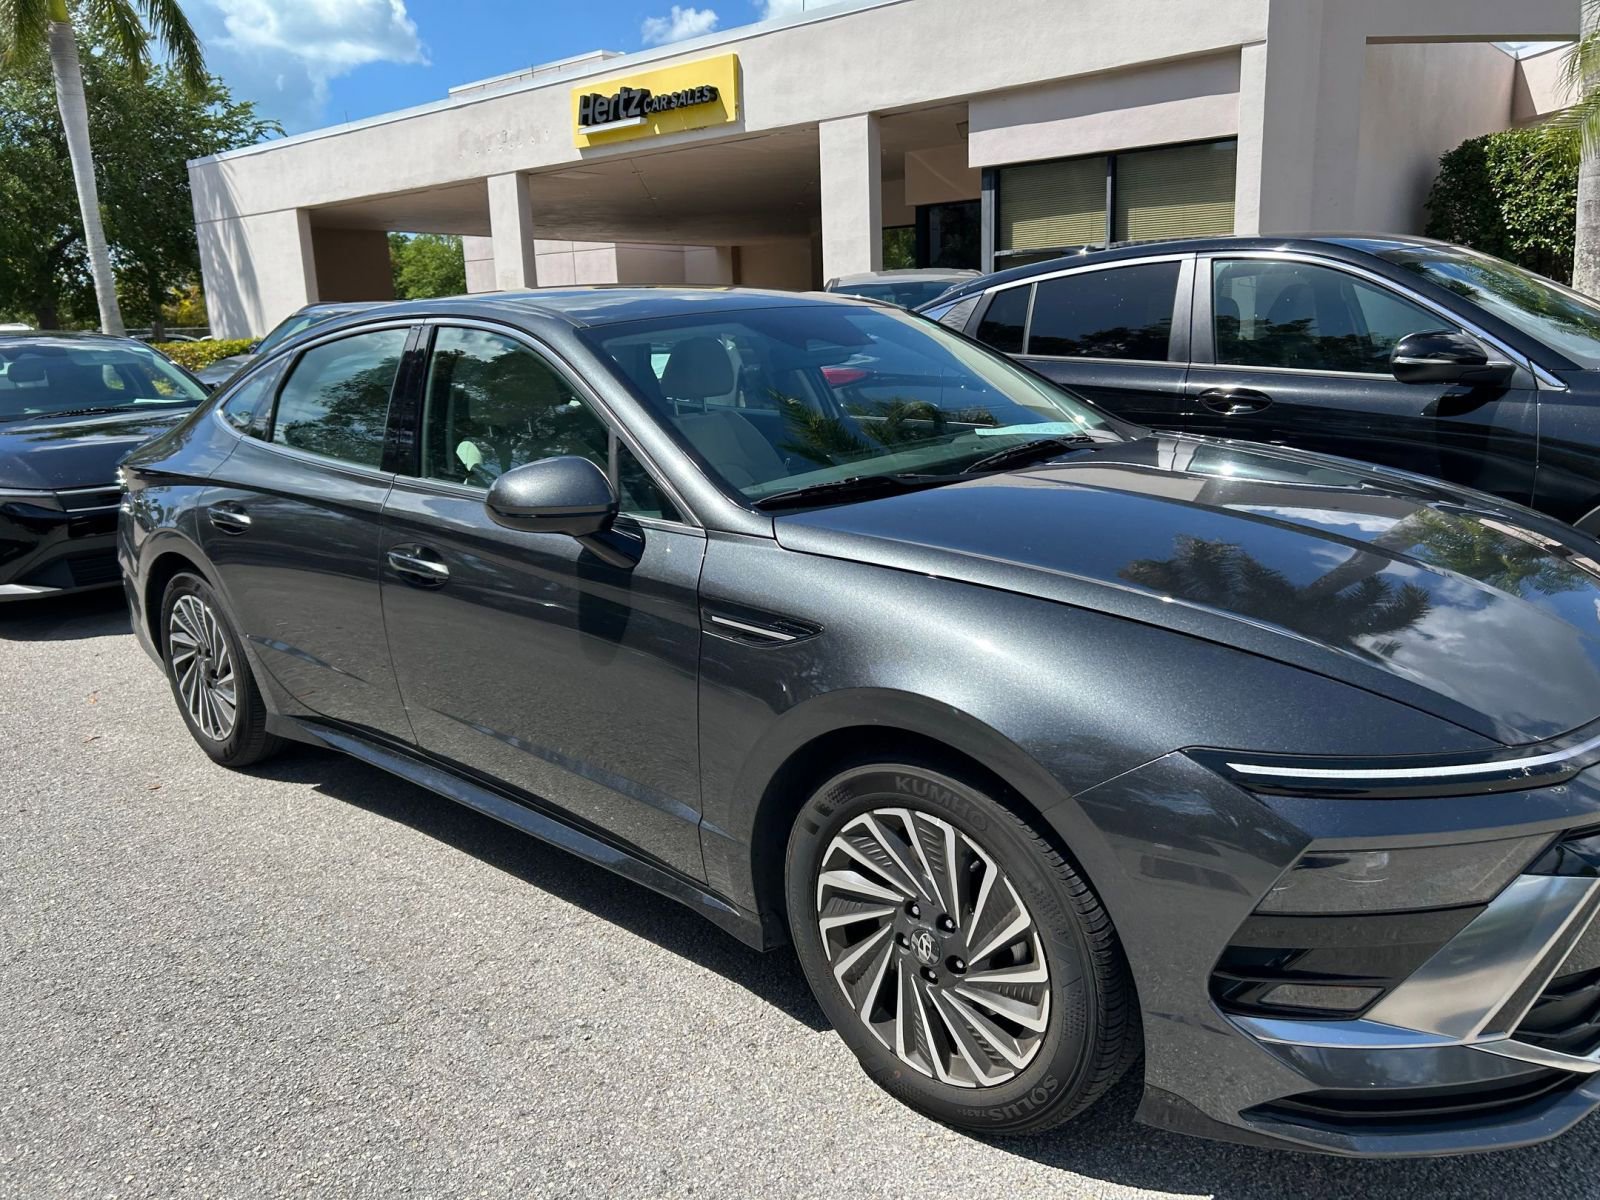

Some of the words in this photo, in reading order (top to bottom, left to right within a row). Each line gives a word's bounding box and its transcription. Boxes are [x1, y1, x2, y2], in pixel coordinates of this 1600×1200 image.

[579, 87, 647, 125] Hertz
[643, 95, 669, 112] CAR
[670, 86, 714, 108] SALES
[894, 776, 987, 831] KUMHO
[988, 1075, 1059, 1121] SOLUS
